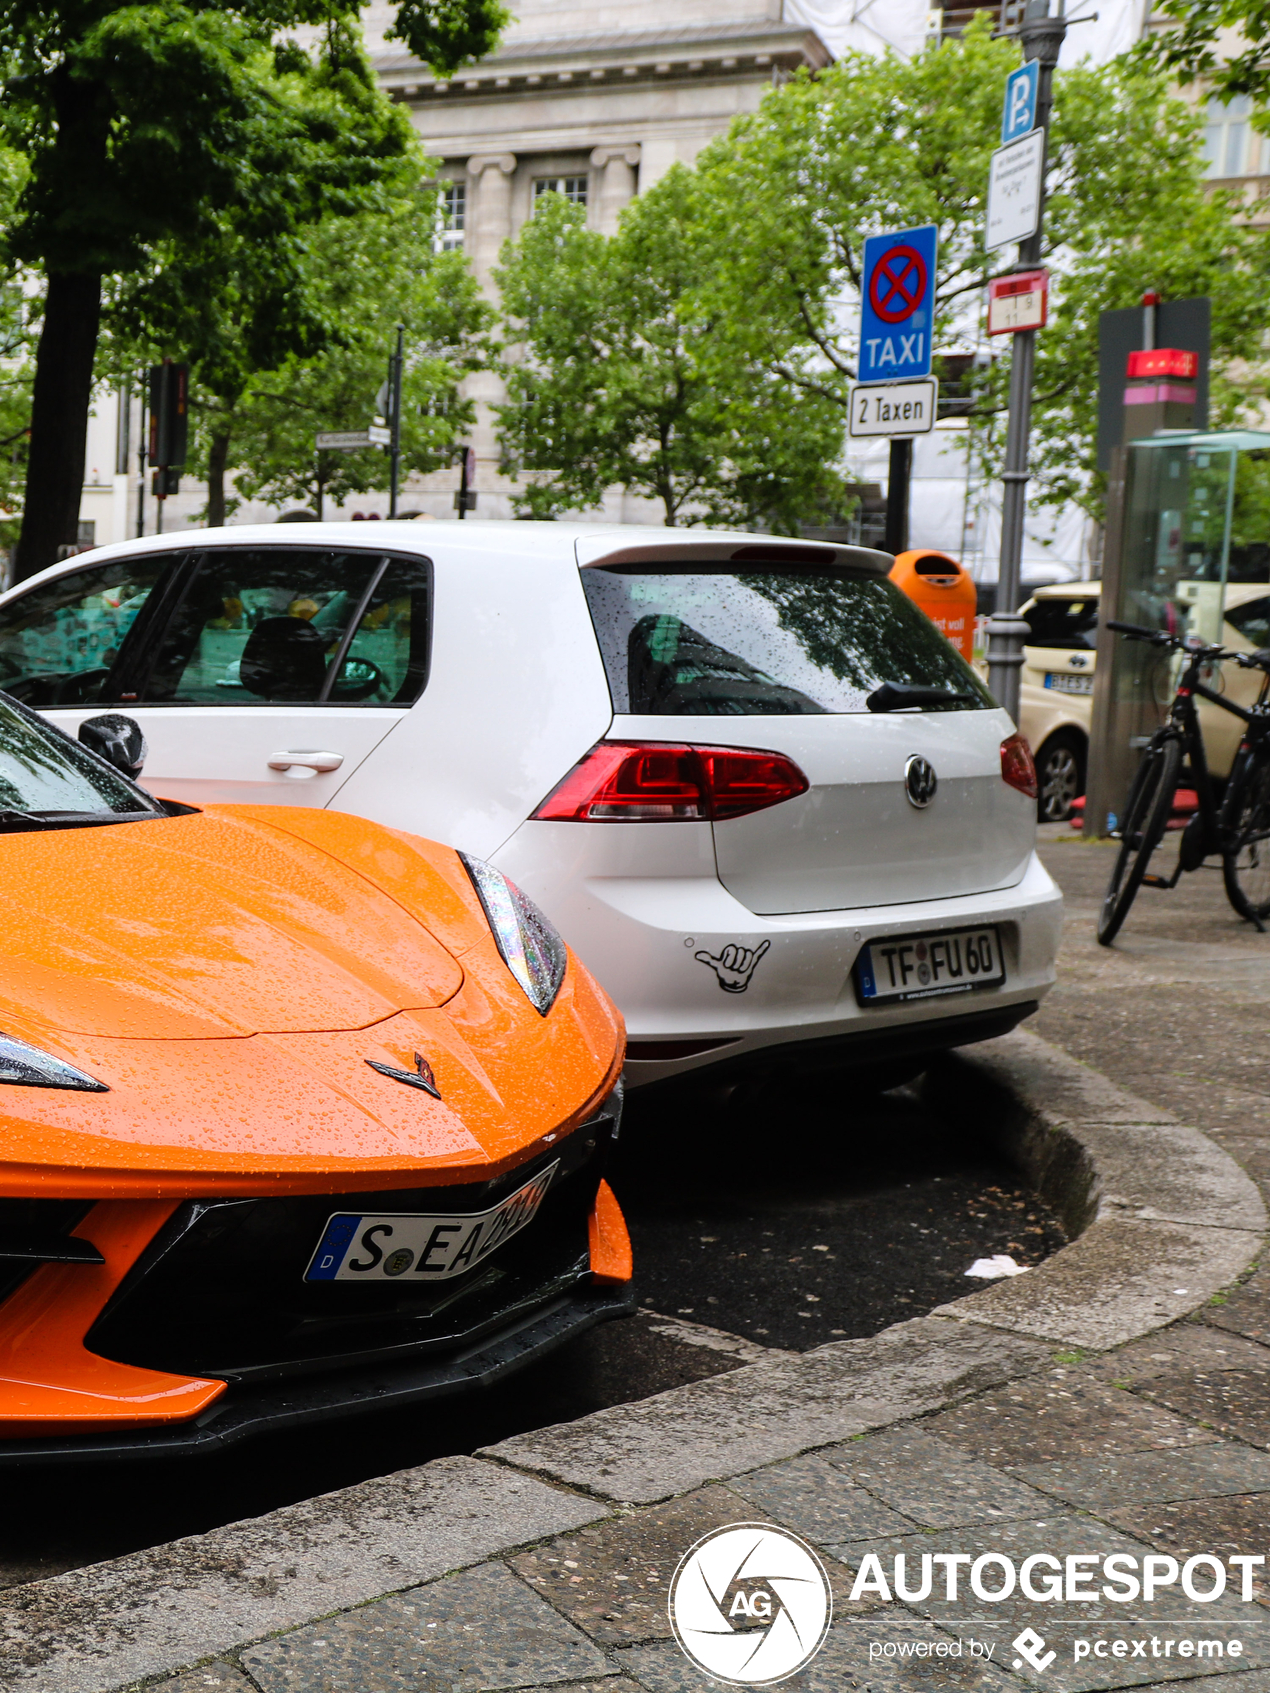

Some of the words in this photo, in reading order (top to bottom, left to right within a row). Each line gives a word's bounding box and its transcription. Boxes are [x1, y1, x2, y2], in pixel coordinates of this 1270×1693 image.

[1008, 74, 1030, 133] P
[865, 332, 924, 368] TAXI
[859, 398, 868, 423] 2
[875, 396, 923, 422] Taxen
